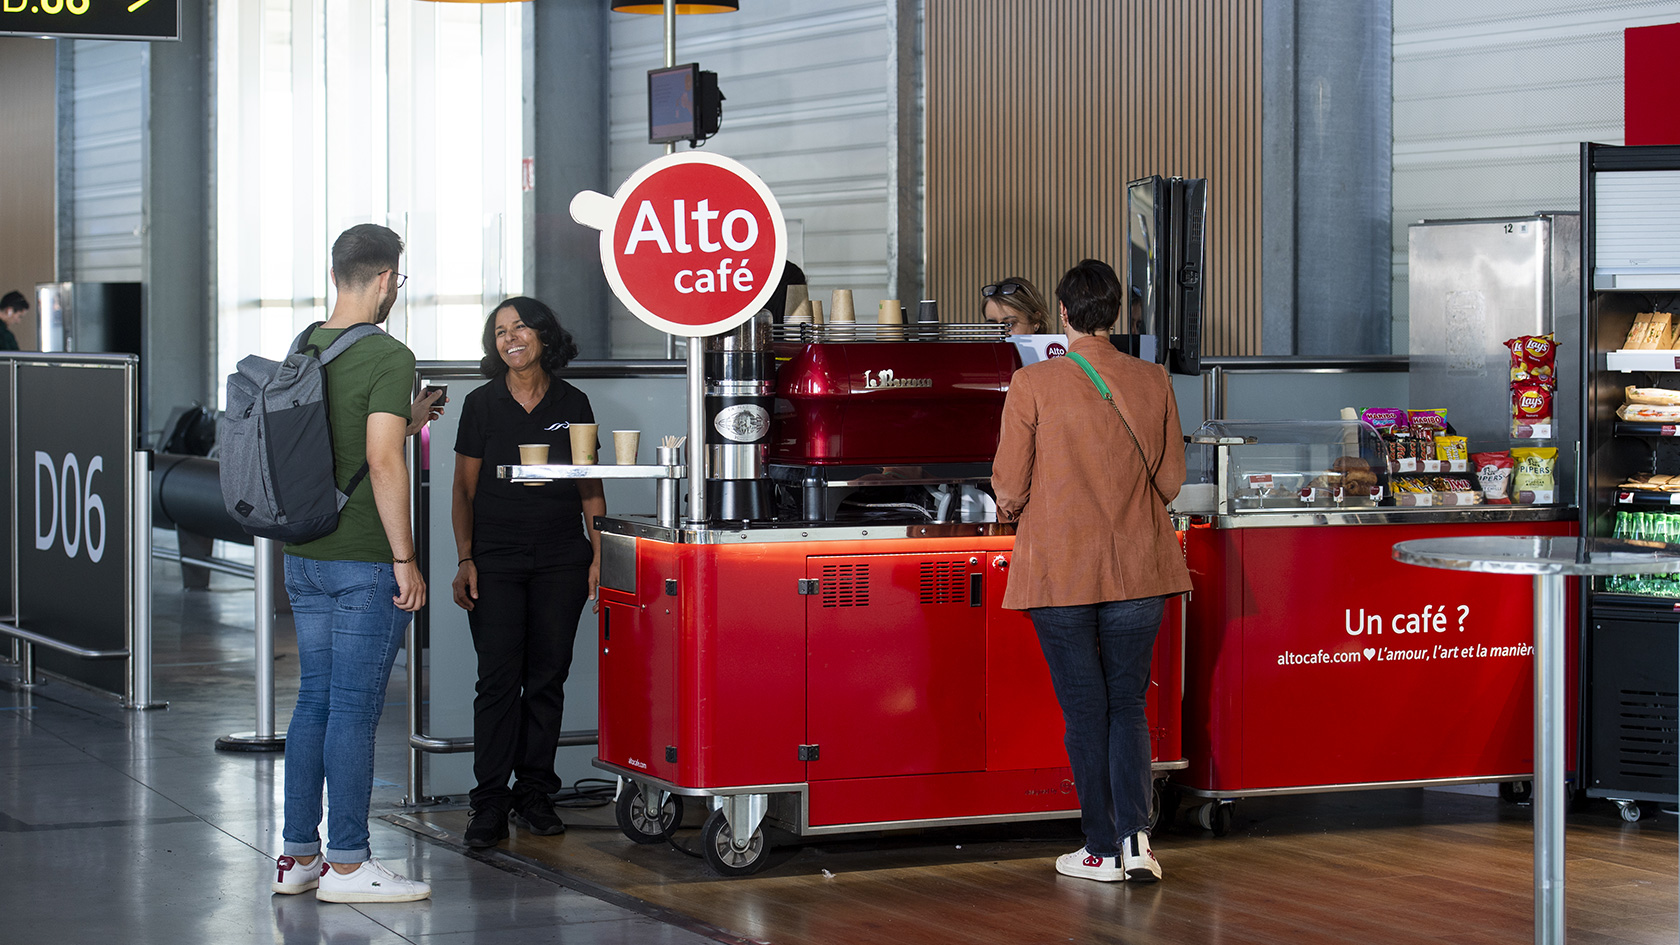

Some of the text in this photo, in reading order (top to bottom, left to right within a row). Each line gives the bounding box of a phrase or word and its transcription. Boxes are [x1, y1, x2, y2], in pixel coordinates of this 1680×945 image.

[623, 198, 759, 255] Alto
[1503, 223, 1513, 234] 12
[673, 258, 754, 294] café
[1048, 347, 1065, 356] Alto
[1526, 340, 1549, 353] Lay's
[1521, 396, 1543, 409] Lay's
[1412, 415, 1441, 424] HARIBO
[1520, 465, 1551, 475] PIPERS
[35, 450, 106, 563] D06
[1345, 604, 1470, 636] Un café ?
[1277, 649, 1361, 665] altocafe.com
[1377, 646, 1430, 661] L'amour,
[1432, 644, 1459, 659] l'art
[1460, 645, 1475, 659] et
[1476, 643, 1488, 658] la
